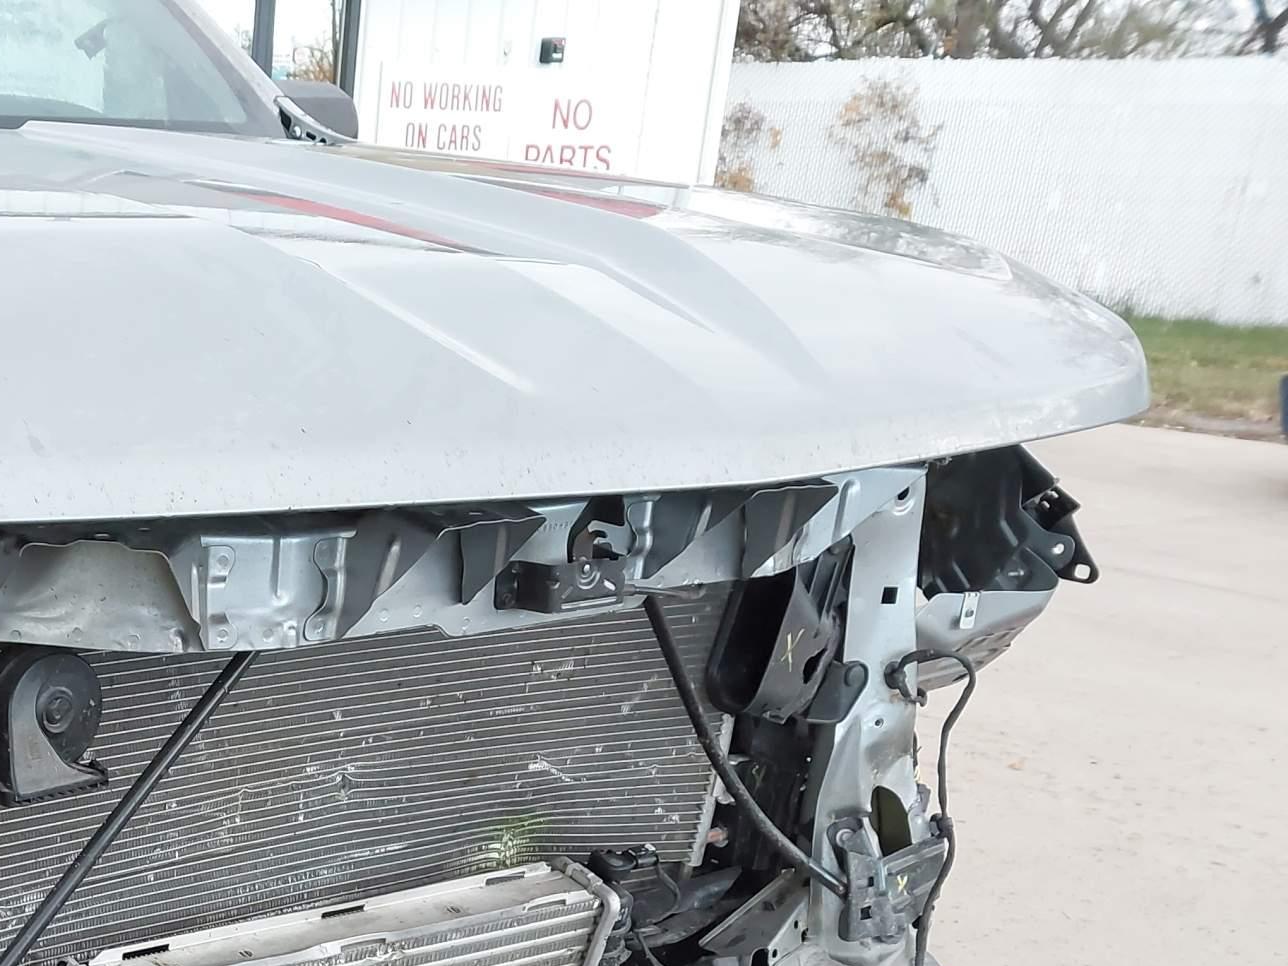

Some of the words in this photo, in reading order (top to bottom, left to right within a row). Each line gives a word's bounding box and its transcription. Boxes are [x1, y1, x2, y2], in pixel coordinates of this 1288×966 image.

[390, 81, 413, 109] NO
[423, 82, 503, 112] WORKING
[552, 99, 592, 130] NO
[405, 122, 428, 149] ON
[437, 123, 482, 151] CARS
[525, 144, 611, 170] PARTS
